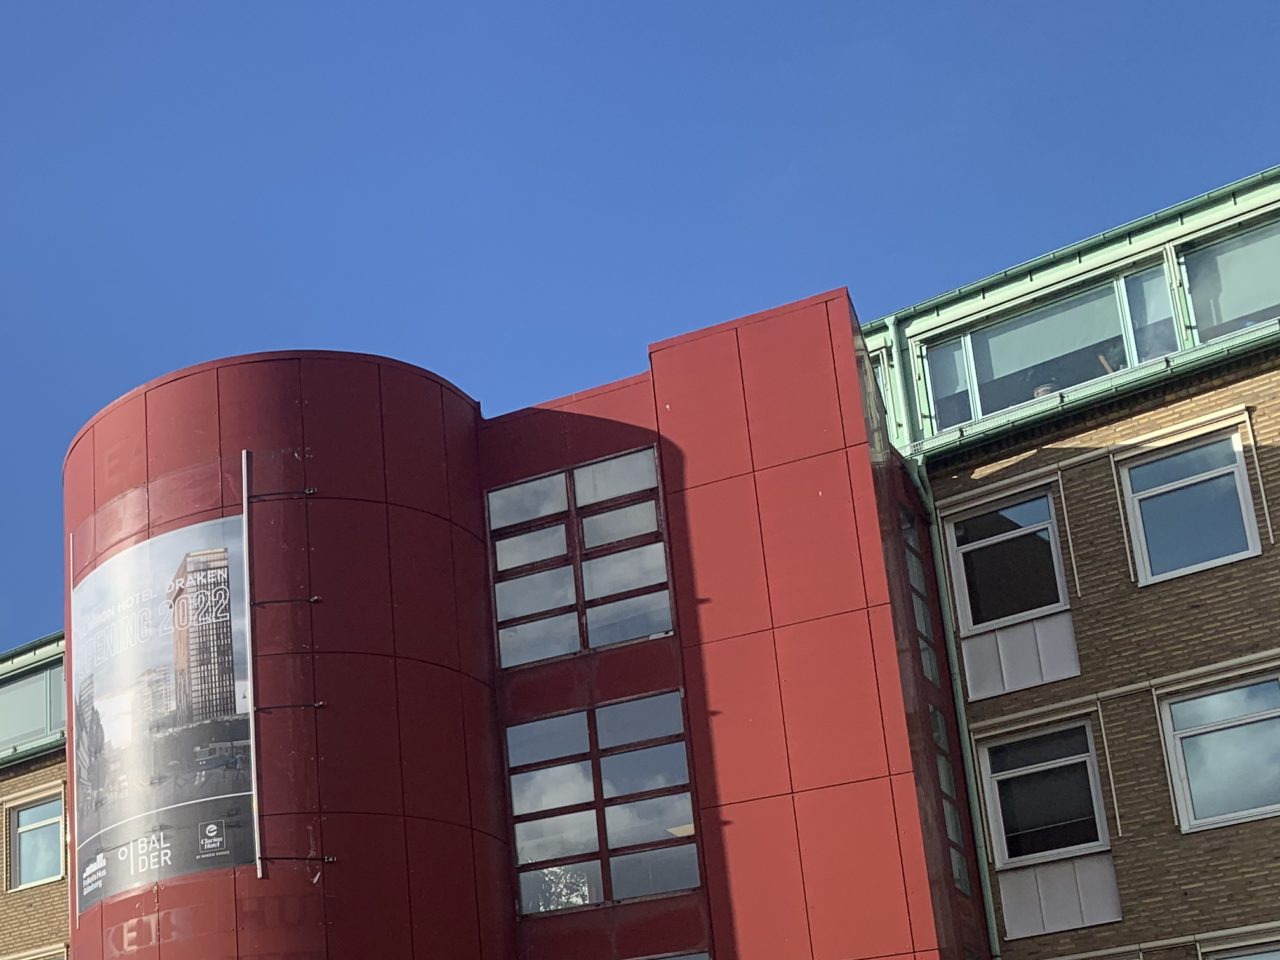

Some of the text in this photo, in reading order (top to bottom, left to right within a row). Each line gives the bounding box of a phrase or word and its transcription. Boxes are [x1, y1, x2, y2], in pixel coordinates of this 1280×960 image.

[118, 588, 156, 612] HOTEL
[166, 568, 228, 592] DRAKEN
[158, 586, 230, 637] 2022
[138, 832, 170, 854] BAL
[138, 849, 172, 873] DER
